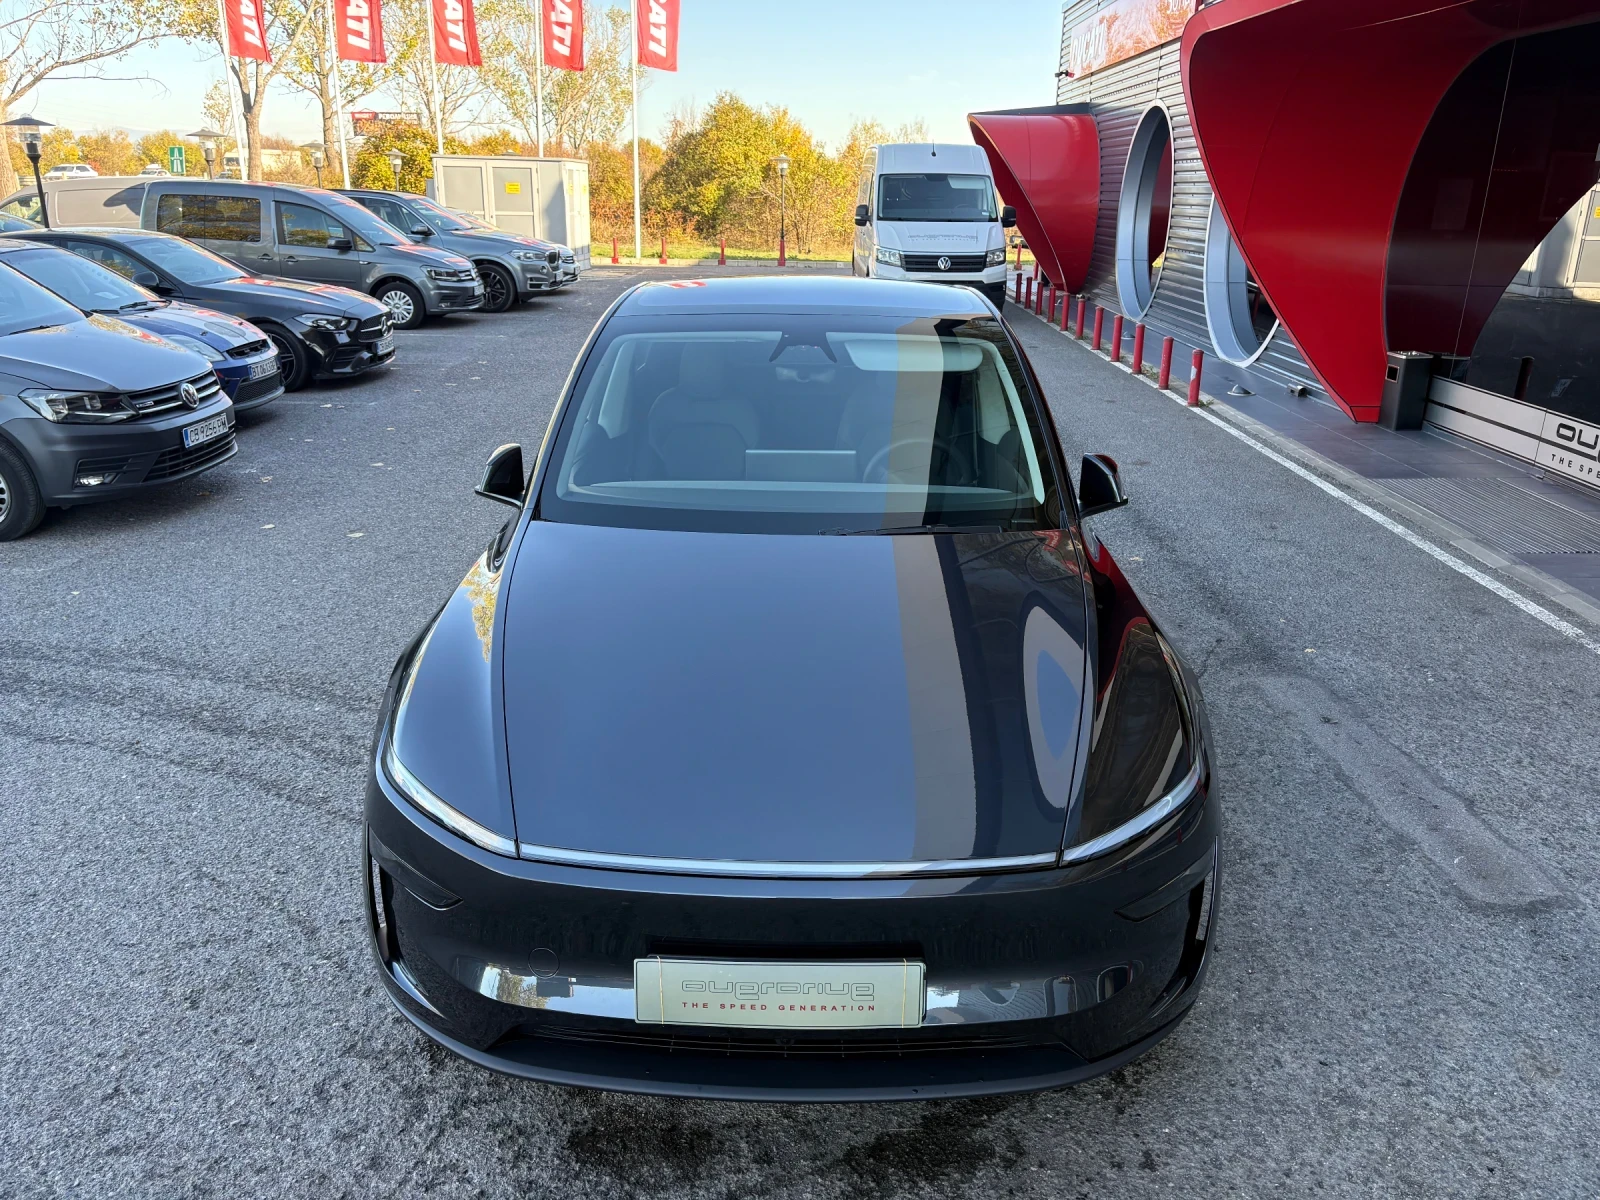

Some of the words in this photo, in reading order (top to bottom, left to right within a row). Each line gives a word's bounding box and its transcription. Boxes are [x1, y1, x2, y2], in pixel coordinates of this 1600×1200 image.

[550, 0, 573, 56] ATI
[648, 0, 667, 58] ATI
[190, 427, 200, 443] CB
[200, 420, 217, 439] 9256
[1551, 453, 1573, 468] THE
[681, 1001, 709, 1009] THE
[719, 1003, 768, 1011] SPEED
[778, 1004, 876, 1012] GENERATION
